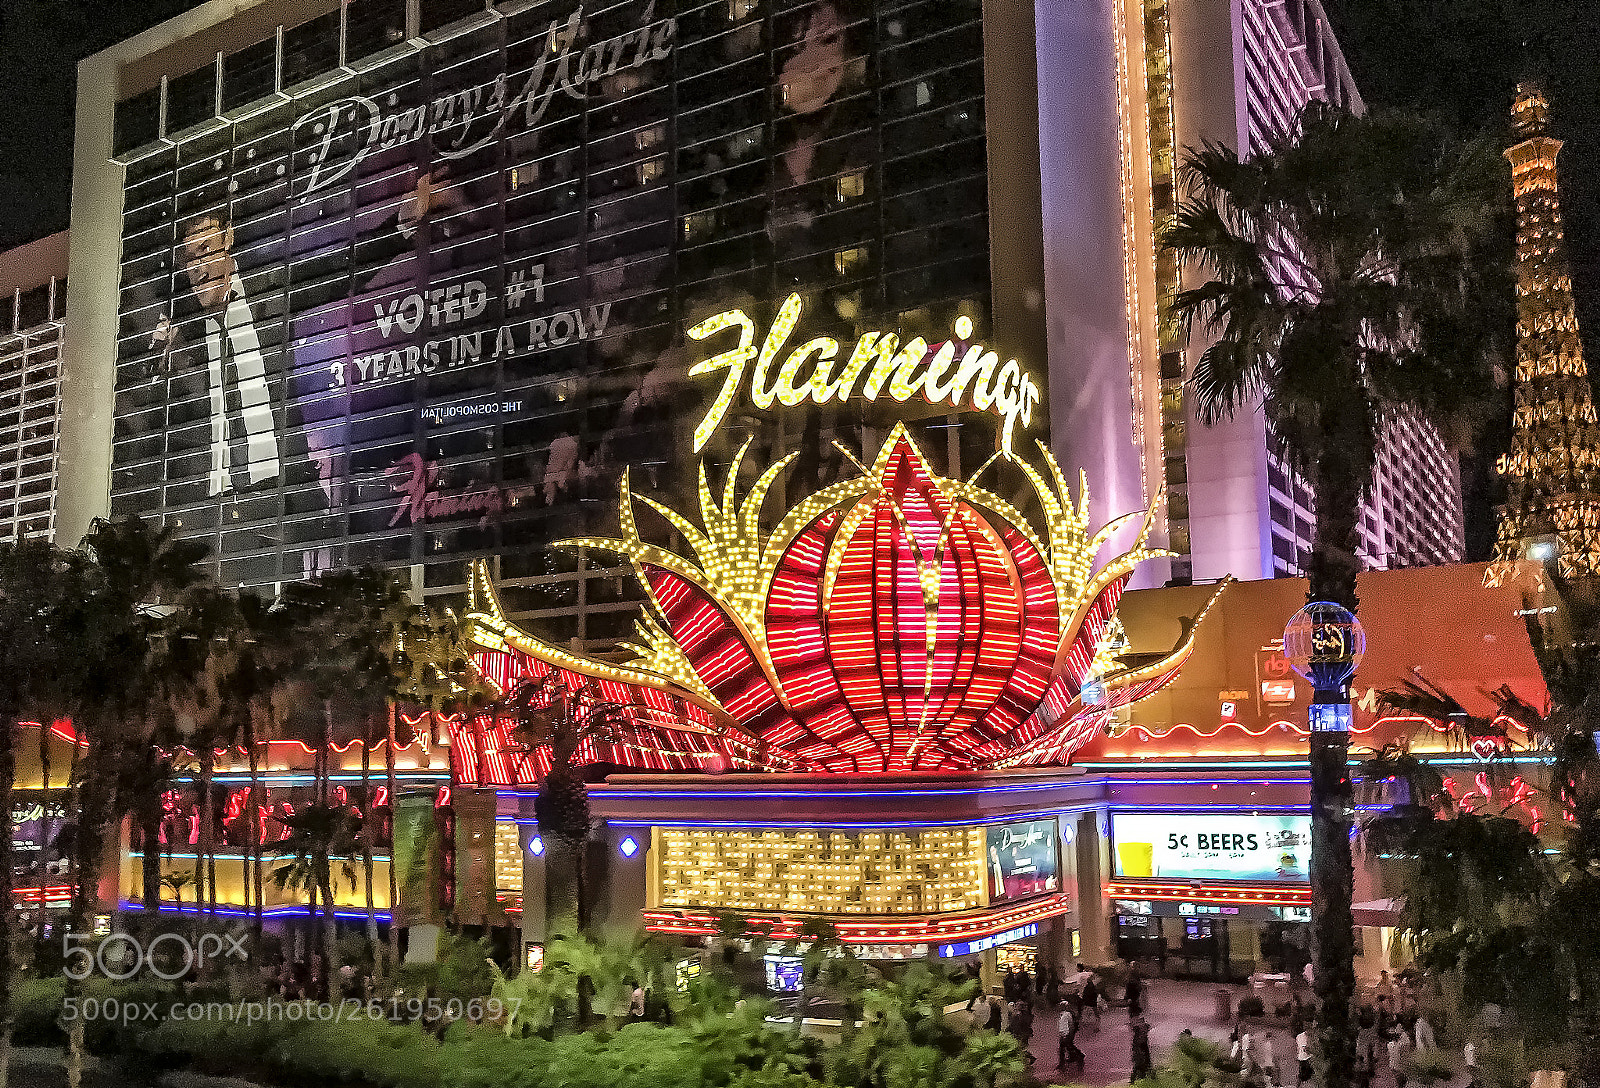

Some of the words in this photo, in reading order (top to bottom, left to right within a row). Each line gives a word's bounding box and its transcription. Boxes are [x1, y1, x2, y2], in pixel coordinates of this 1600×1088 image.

[374, 280, 488, 338] VOTED
[505, 264, 545, 310] #1
[328, 362, 345, 391] 3
[353, 341, 440, 386] YEARS
[449, 332, 482, 367] IN
[492, 326, 516, 358] A
[527, 303, 613, 350] ROW
[687, 292, 1040, 460] Flamingo
[1197, 833, 1258, 850] BEERS
